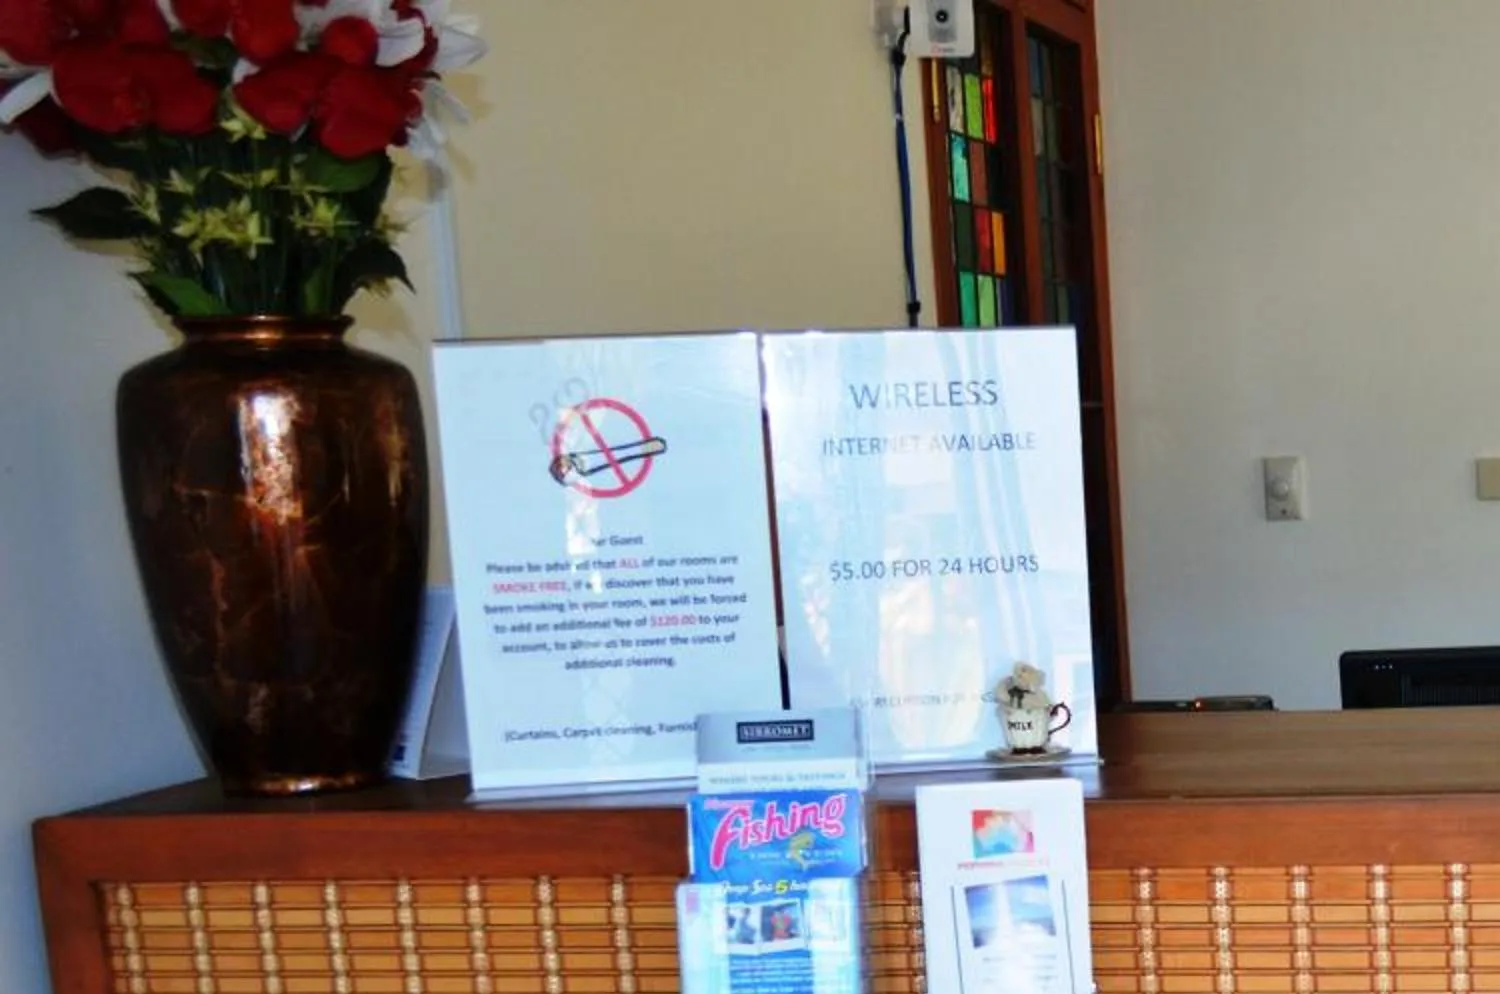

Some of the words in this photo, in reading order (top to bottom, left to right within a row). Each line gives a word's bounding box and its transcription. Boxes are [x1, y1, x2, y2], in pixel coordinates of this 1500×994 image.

[850, 379, 998, 409] WIRELESS
[823, 437, 928, 456] INTERNET
[930, 431, 1037, 452] AVAILABLE
[486, 562, 524, 574] Please
[527, 562, 541, 573] be
[545, 560, 590, 573] advied
[592, 559, 616, 570] that
[618, 558, 640, 570] ALL
[642, 555, 655, 567] of
[657, 558, 677, 567] our
[680, 556, 717, 566] rooms
[720, 555, 739, 565] are
[829, 560, 885, 581] $5.00
[892, 559, 932, 577] FOR
[938, 557, 962, 576] 24
[969, 554, 1039, 575] HOURS
[606, 578, 653, 590] discover
[656, 576, 679, 587] that
[682, 577, 705, 588] you
[707, 574, 735, 585] have
[516, 602, 565, 614] smoking
[581, 600, 609, 612] your
[669, 595, 690, 606] will
[693, 594, 707, 605] be
[710, 592, 748, 604] forced
[510, 621, 533, 633] add
[553, 619, 611, 631] additional
[635, 616, 647, 627] of
[698, 614, 712, 626] to
[713, 614, 740, 627] your
[554, 641, 567, 651] to
[620, 638, 633, 648] to
[635, 636, 667, 647] cover
[669, 634, 689, 645] the
[723, 631, 736, 643] of
[564, 657, 623, 670] additional
[709, 793, 848, 872] Fishing
